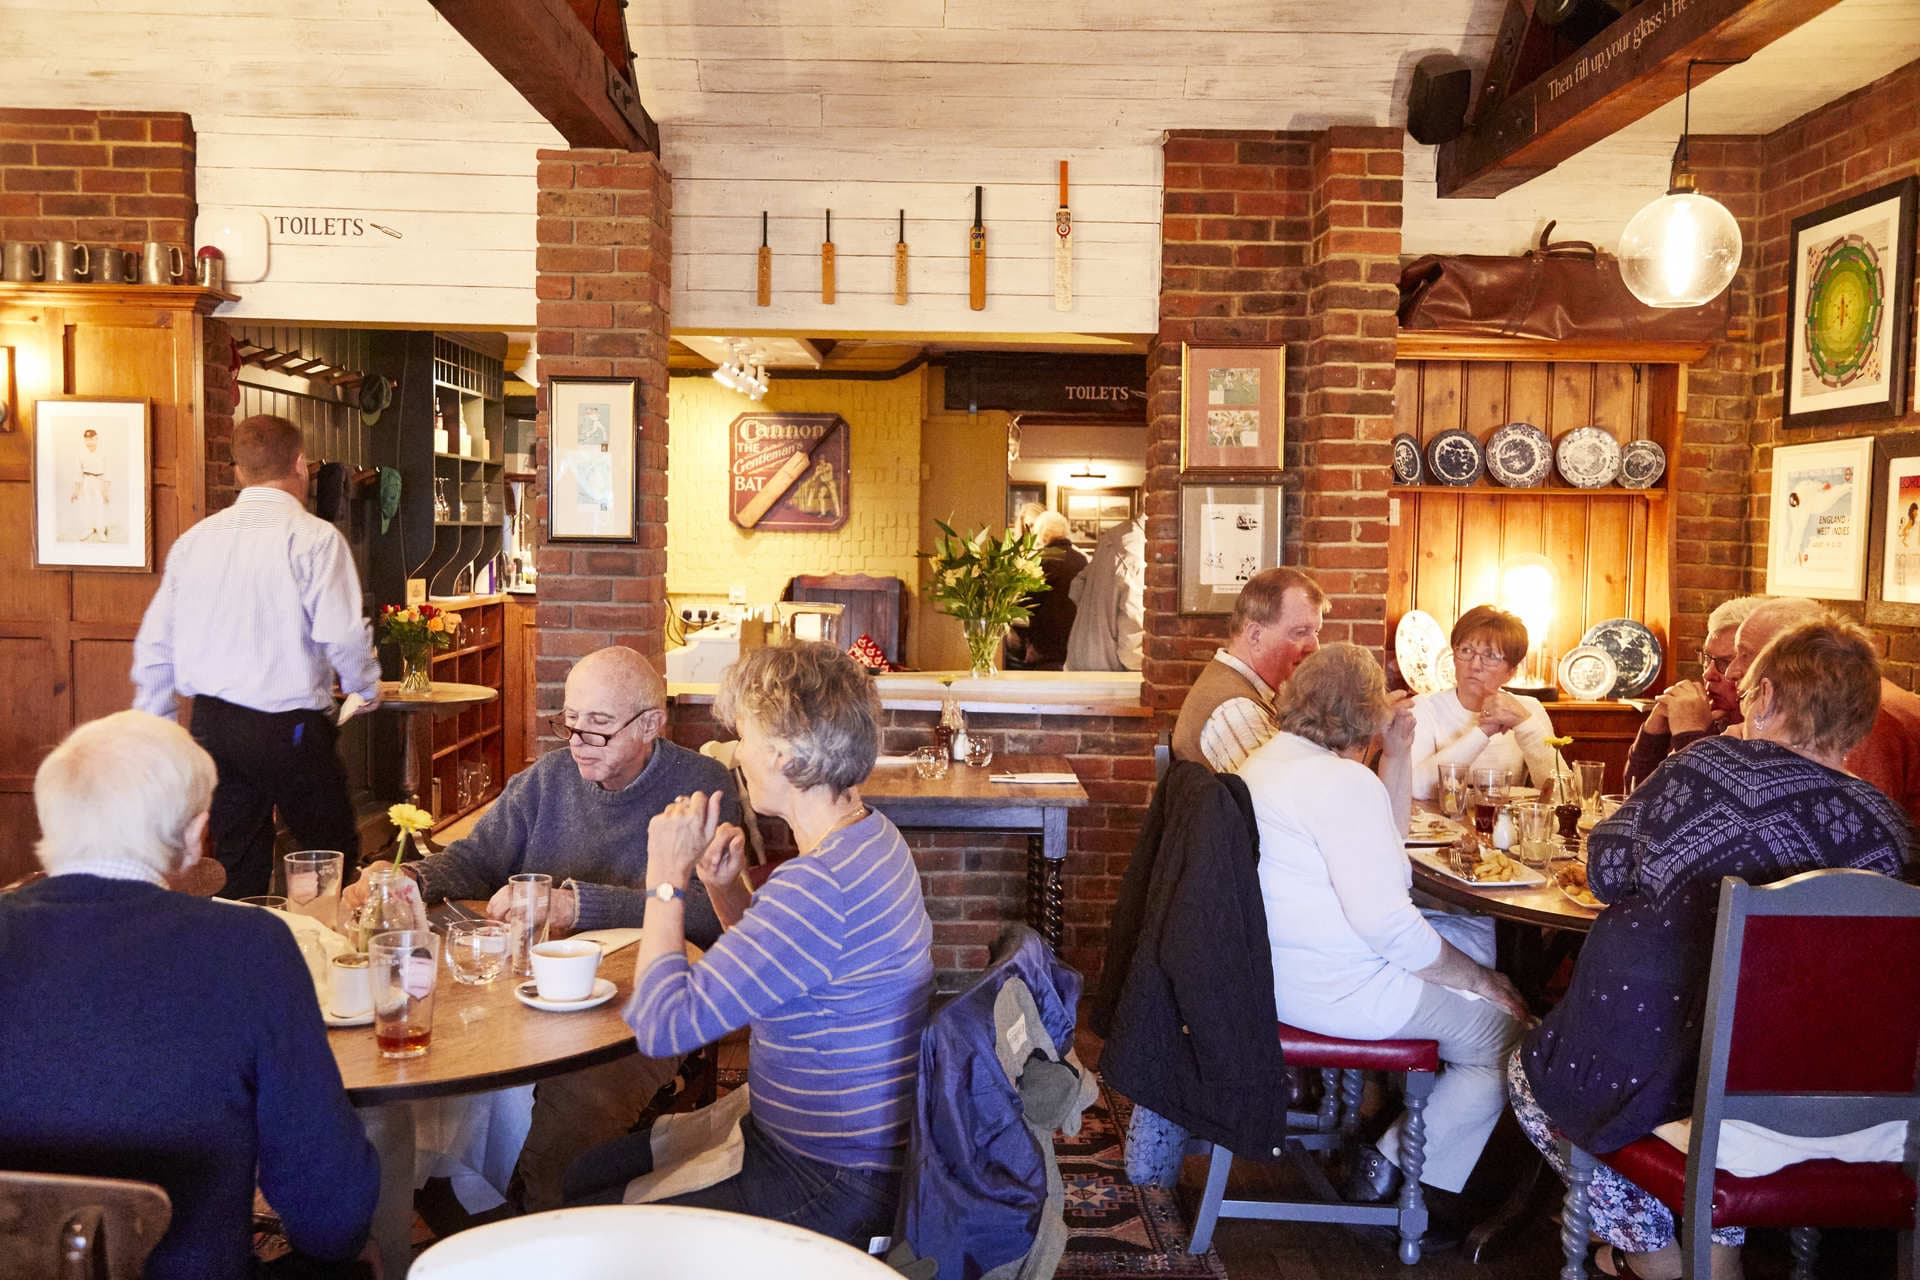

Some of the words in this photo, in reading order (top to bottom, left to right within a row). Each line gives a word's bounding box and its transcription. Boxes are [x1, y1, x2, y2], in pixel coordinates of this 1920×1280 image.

[1547, 76, 1573, 101] Then
[1574, 57, 1589, 83] fill
[1591, 50, 1604, 74] up
[1603, 32, 1631, 69] your
[1633, 2, 1667, 49] glass!
[274, 216, 364, 236] TOILETS
[1065, 385, 1129, 401] TOILETS
[740, 419, 825, 441] Cannon
[737, 442, 761, 454] THE
[735, 476, 767, 492] BAT
